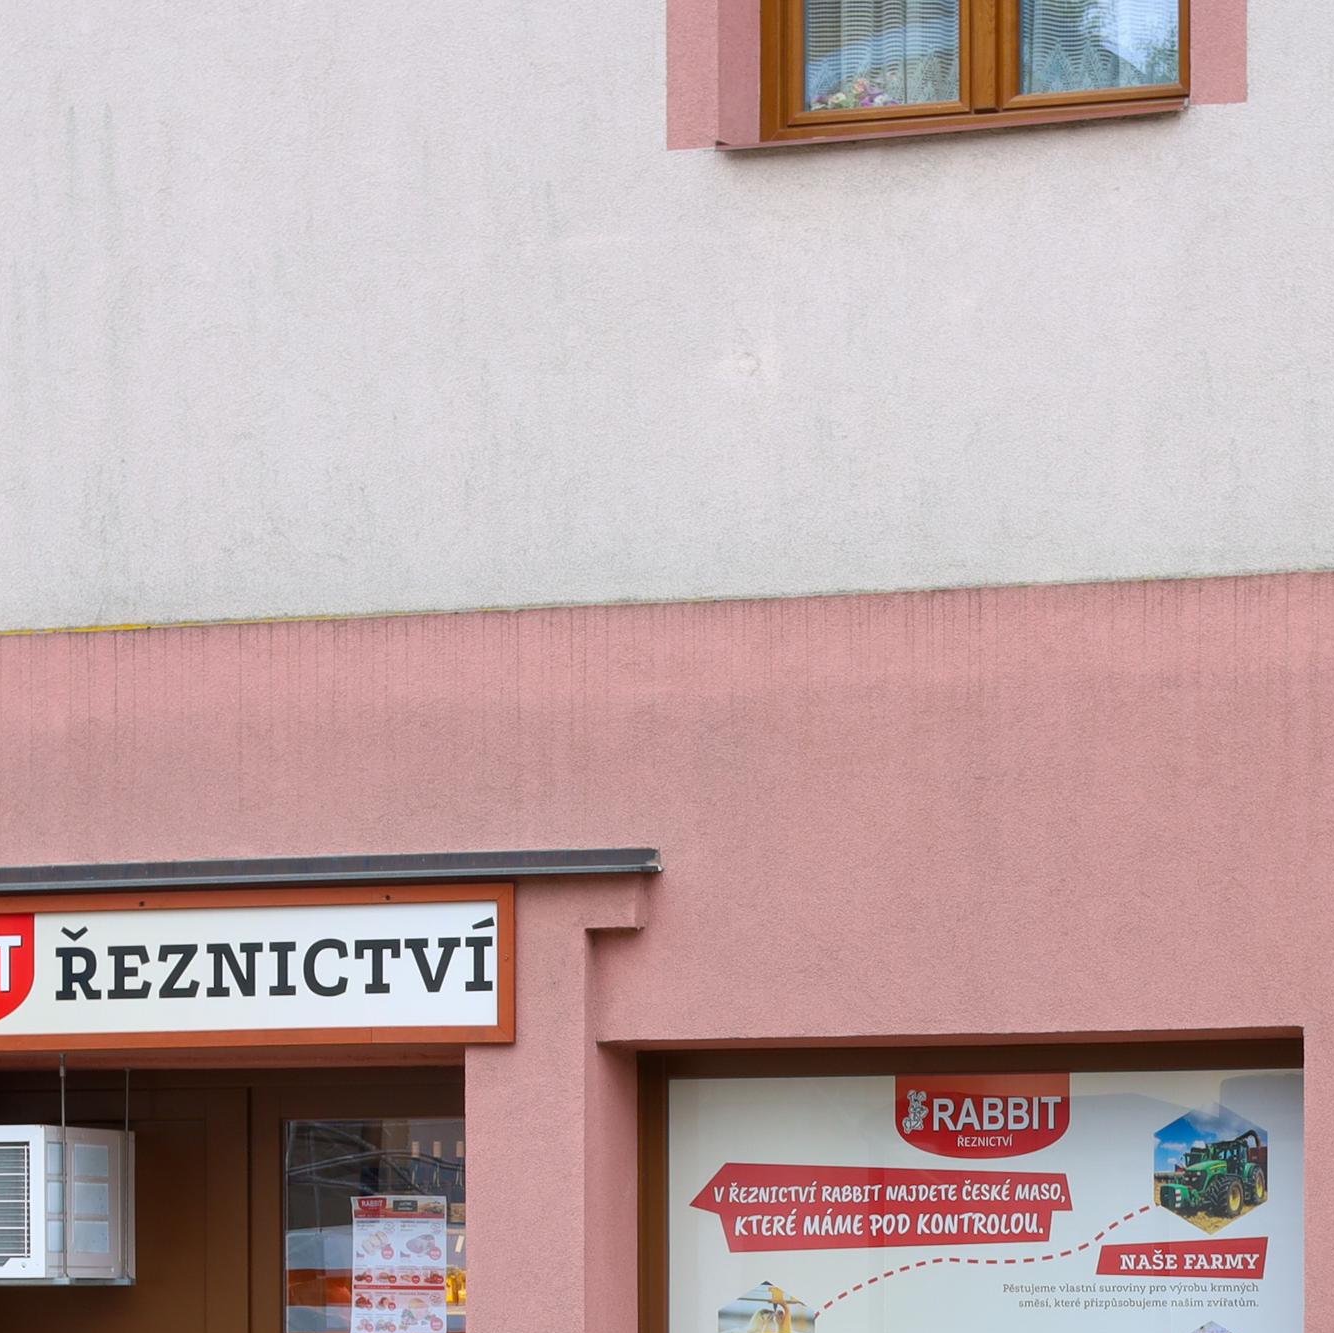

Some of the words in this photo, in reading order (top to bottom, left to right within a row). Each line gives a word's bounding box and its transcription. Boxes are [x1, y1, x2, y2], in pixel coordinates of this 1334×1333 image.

[55, 916, 495, 1001] ŘEZNICTVÍ
[933, 1096, 1061, 1131] RABBIT
[957, 1135, 1012, 1147] ŘEZNICTVÍ
[714, 1187, 725, 1203] V
[728, 1182, 817, 1204] ŘEZNICTVÍ
[821, 1184, 879, 1203] RABBIT
[886, 1183, 958, 1201] NAJDETE
[962, 1178, 1010, 1202] ČESKÉ
[1014, 1183, 1065, 1204] MASO,
[735, 1211, 796, 1236] KTERÉ
[803, 1210, 863, 1236] MÁME
[870, 1214, 910, 1236] POD
[917, 1212, 1044, 1235] KONTROLOU.
[1120, 1250, 1177, 1270] NAŠE
[1184, 1253, 1259, 1269] FARMY
[1002, 1283, 1056, 1295] Pěstujeme
[1059, 1283, 1096, 1293] vlastní
[1099, 1284, 1146, 1295] suroviny
[1149, 1285, 1166, 1295] pro
[1170, 1283, 1207, 1294] výrobu
[1210, 1283, 1259, 1294] krmných
[1018, 1298, 1051, 1309] směsí,
[1054, 1298, 1080, 1308] které
[1084, 1298, 1167, 1310] přizpůsobujeme
[1207, 1298, 1259, 1308] zvířatům.
